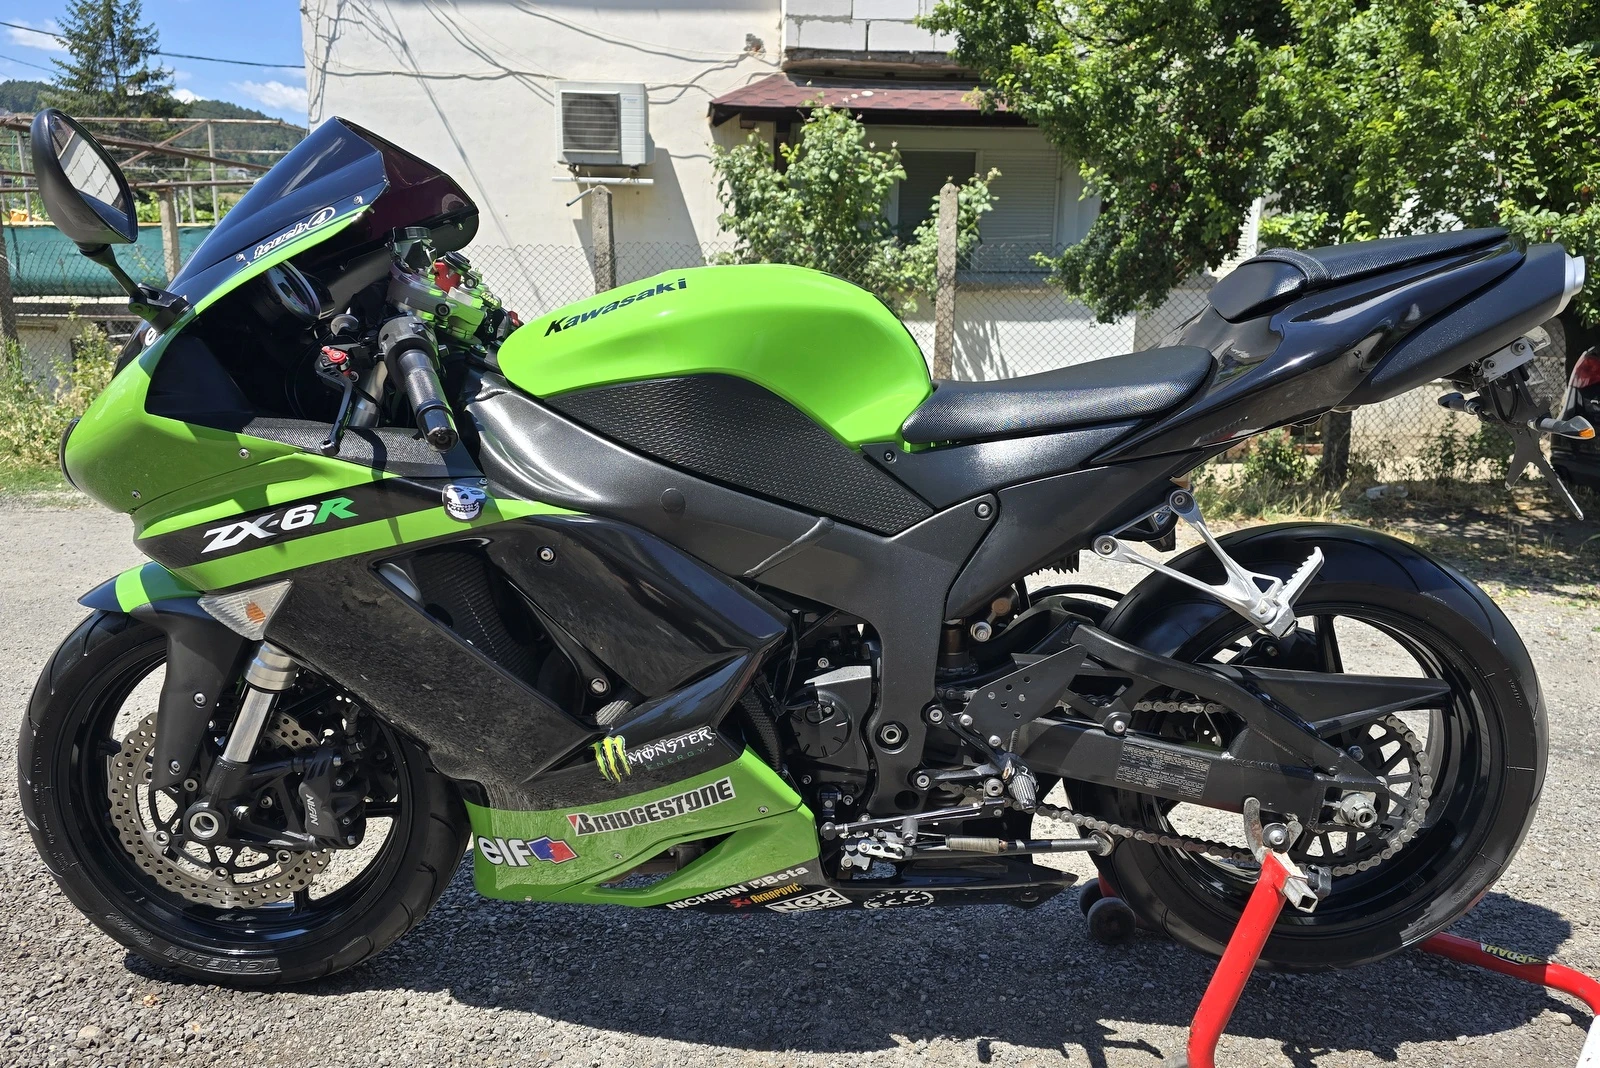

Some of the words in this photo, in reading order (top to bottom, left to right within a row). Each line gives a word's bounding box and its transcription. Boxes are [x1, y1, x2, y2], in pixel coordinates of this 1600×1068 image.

[544, 278, 688, 337] Kawasaki
[201, 497, 359, 554] ZX-6R
[627, 727, 714, 766] MONSTER
[477, 836, 531, 867] elf
[765, 866, 809, 886] Beta
[666, 884, 749, 910] NICHIRIN
[770, 891, 841, 912] NGK
[163, 945, 281, 973] ICHELIN
